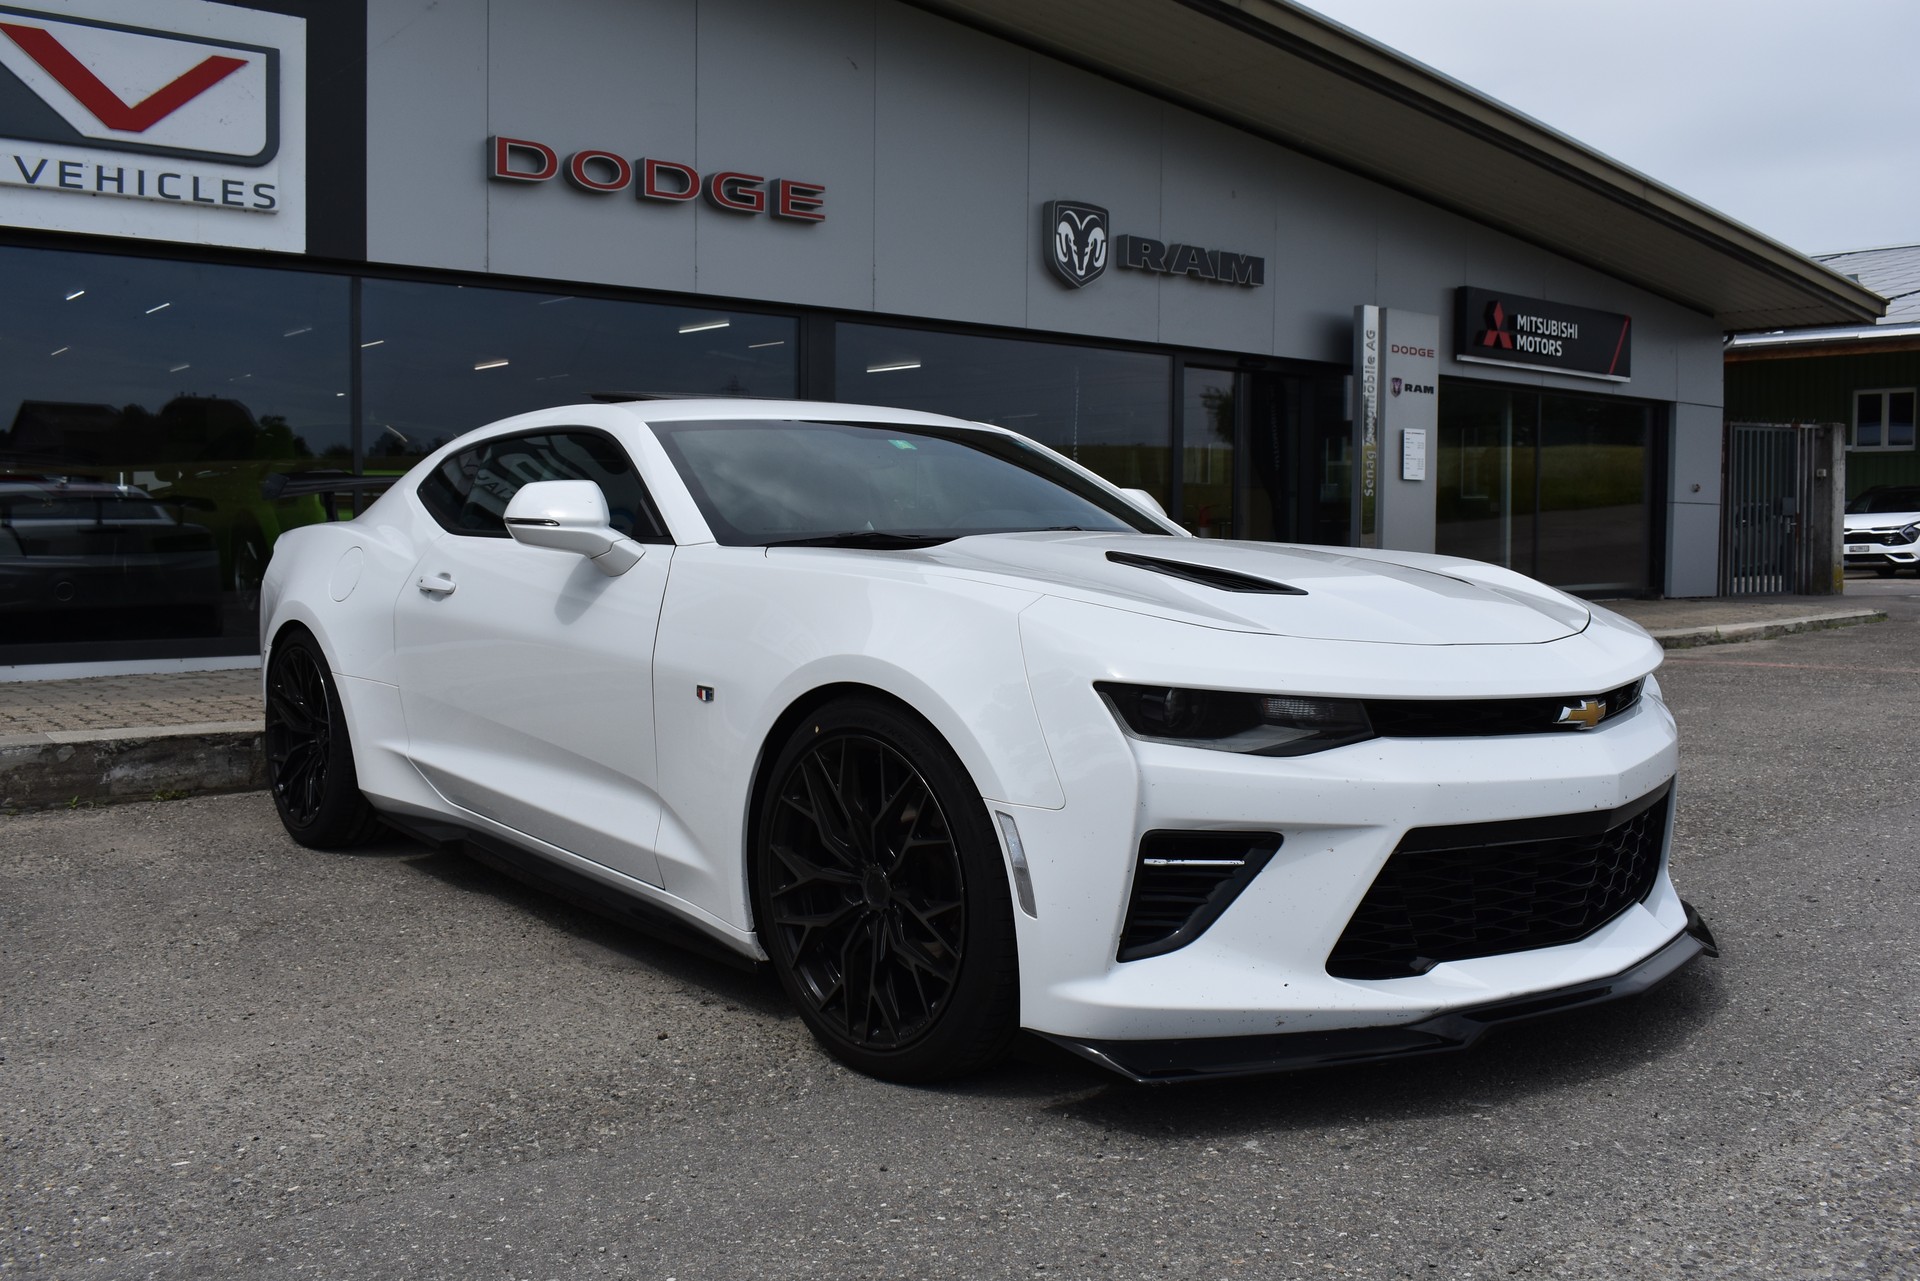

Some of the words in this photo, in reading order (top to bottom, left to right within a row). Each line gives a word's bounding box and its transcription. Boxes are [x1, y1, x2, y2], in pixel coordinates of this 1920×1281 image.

[13, 155, 277, 210] VEHICLES
[490, 134, 826, 222] DODGE
[1117, 233, 1265, 287] RAM
[1365, 329, 1376, 351] AG
[1516, 313, 1578, 340] MITSUBISHI
[1391, 344, 1435, 358] DODGE
[1516, 334, 1563, 357] MOTORS
[1404, 383, 1435, 395] RAM
[1364, 451, 1377, 497] Senag
